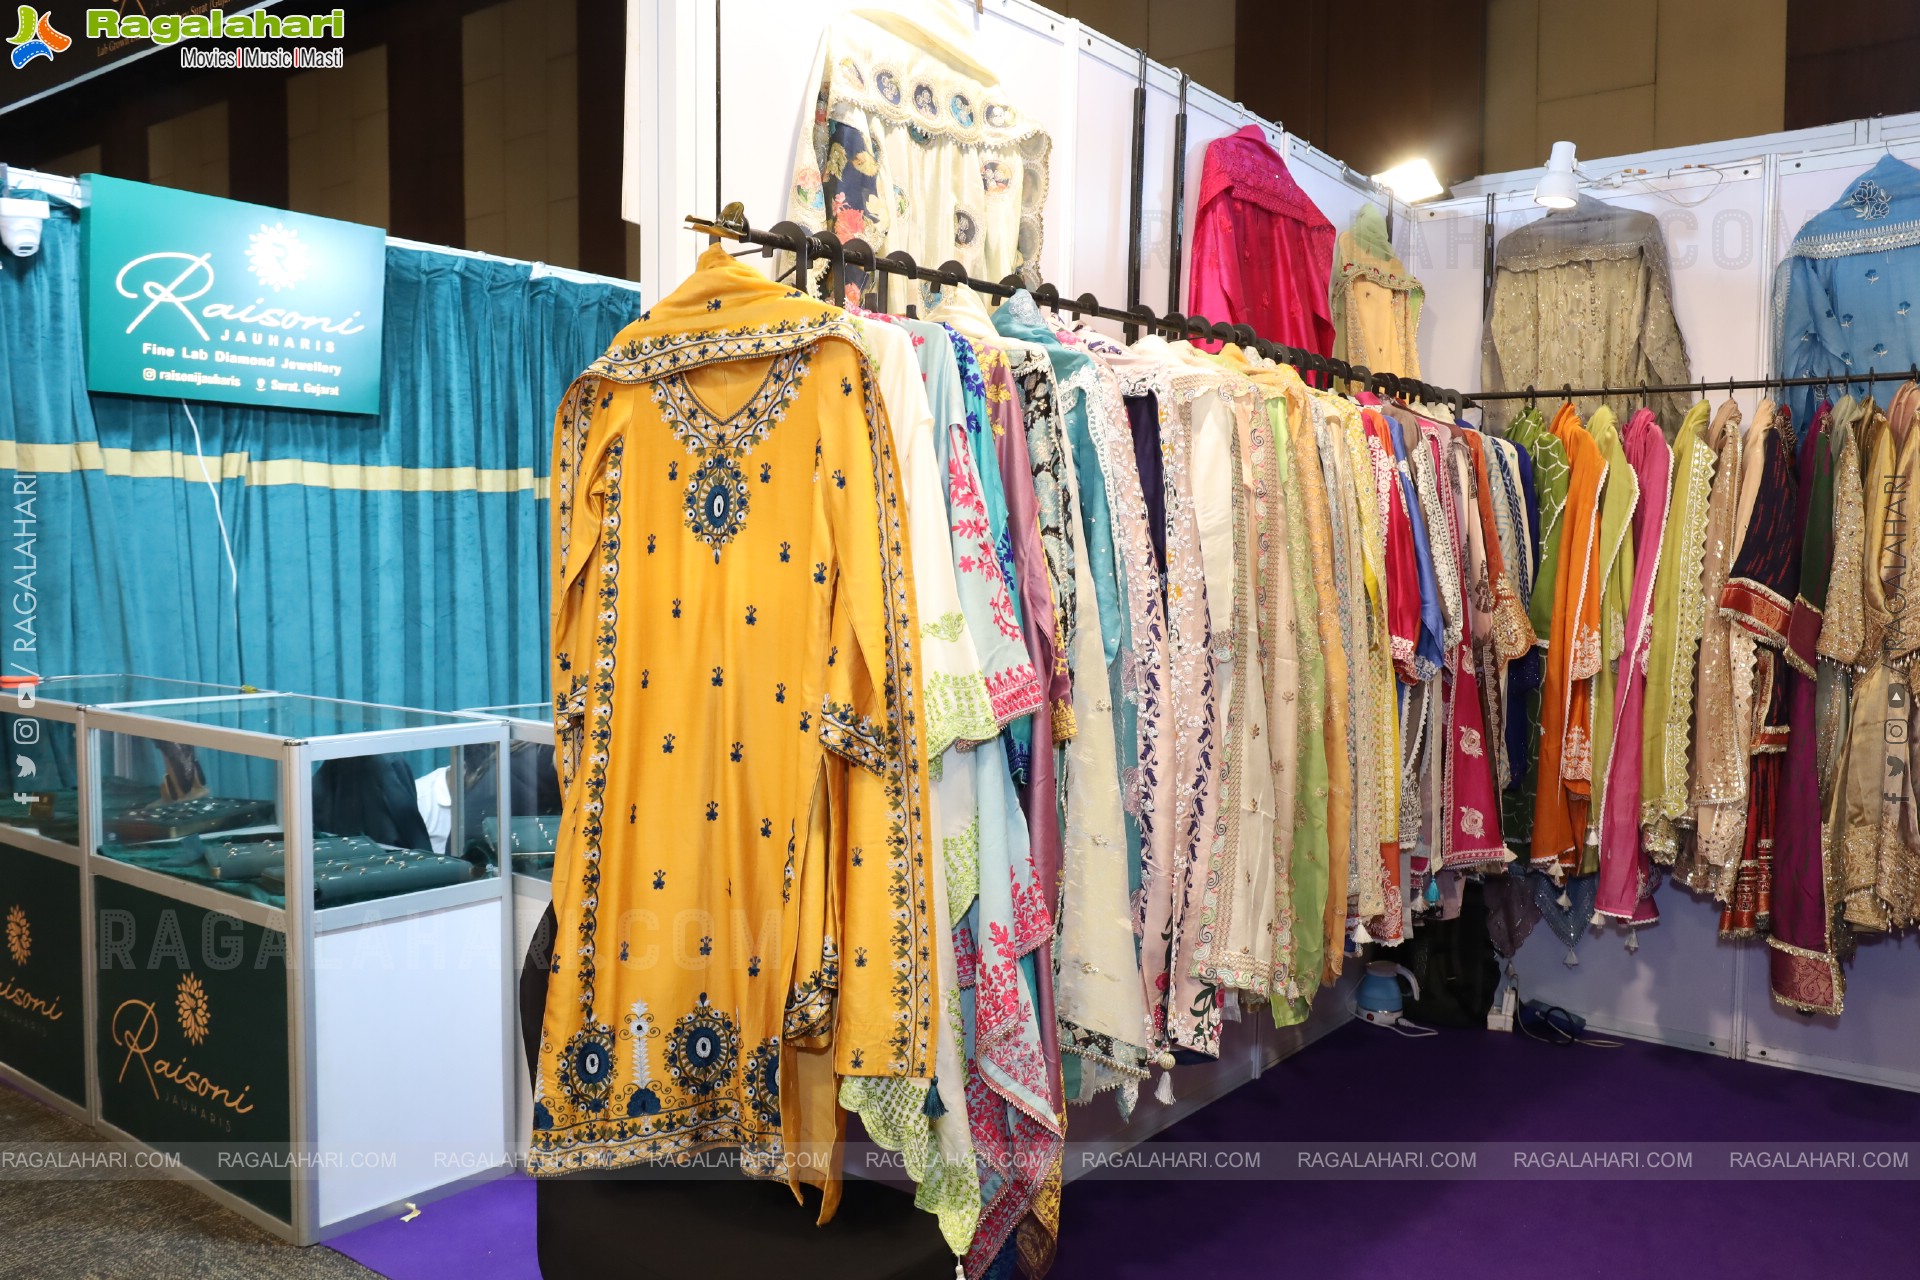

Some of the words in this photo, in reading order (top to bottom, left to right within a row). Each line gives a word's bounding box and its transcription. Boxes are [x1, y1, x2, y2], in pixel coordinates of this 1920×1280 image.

[116, 252, 365, 342] Raisoni
[142, 343, 175, 358] Fine
[182, 347, 208, 361] Lab
[215, 350, 275, 368] Diamond
[281, 358, 342, 377] Jewellery
[220, 329, 335, 353] JAUHARIS
[159, 369, 241, 387] raisonijauharis
[303, 382, 340, 397] Gujarat
[0, 976, 63, 1020] isoni
[112, 999, 254, 1114] Raisoni
[165, 1091, 232, 1134] JAUHARIS
